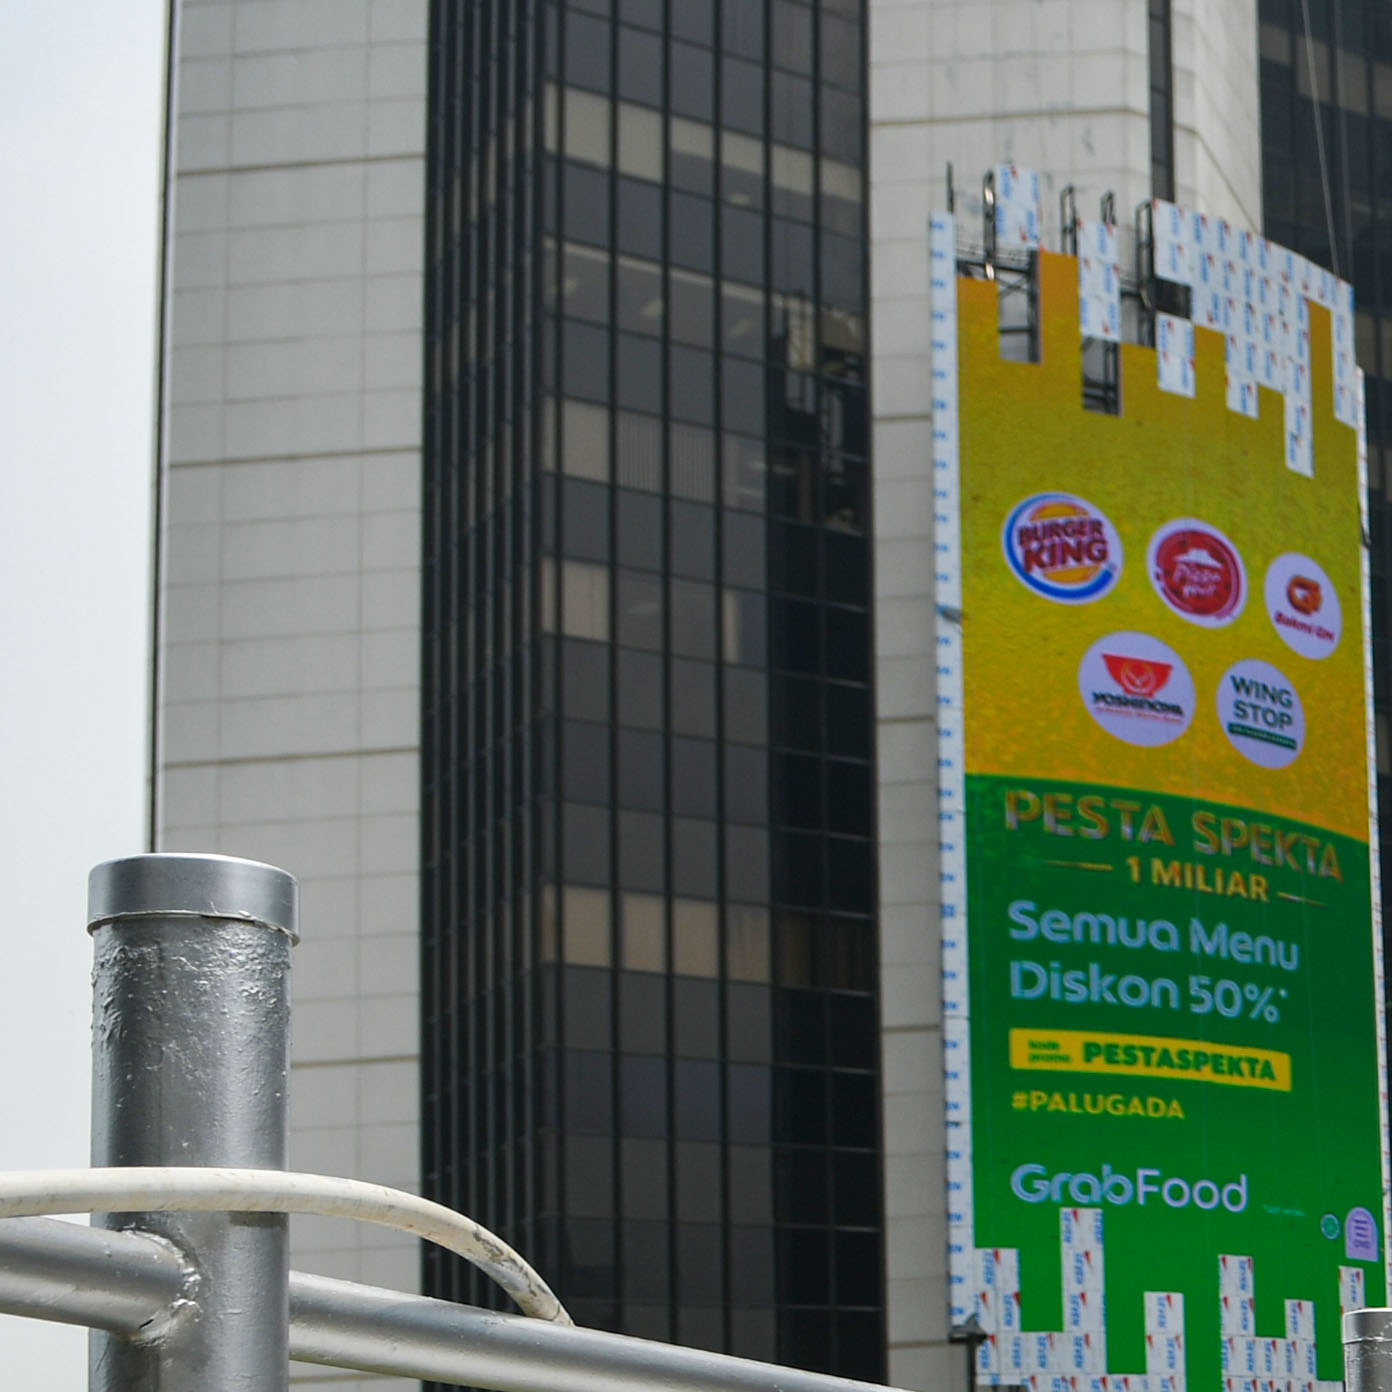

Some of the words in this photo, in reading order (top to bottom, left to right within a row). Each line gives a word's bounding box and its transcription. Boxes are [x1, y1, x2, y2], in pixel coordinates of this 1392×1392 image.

[1017, 518, 1105, 547] BURGER
[1023, 538, 1109, 574] KING
[1229, 673, 1294, 709] WING
[1233, 698, 1293, 731] STOP
[1004, 789, 1177, 847] PESTA
[1191, 809, 1345, 884] SPEKTA
[1125, 855, 1141, 884] 1
[1151, 857, 1271, 902] MILIAR
[1007, 899, 1182, 952] Semua
[1188, 916, 1300, 972] Menu
[1009, 959, 1181, 1011] Diskon
[1082, 1041, 1278, 1083] PESTASPEKTA
[1011, 1090, 1186, 1120] #PALUGADA
[1009, 1161, 1249, 1214] GrabFood
